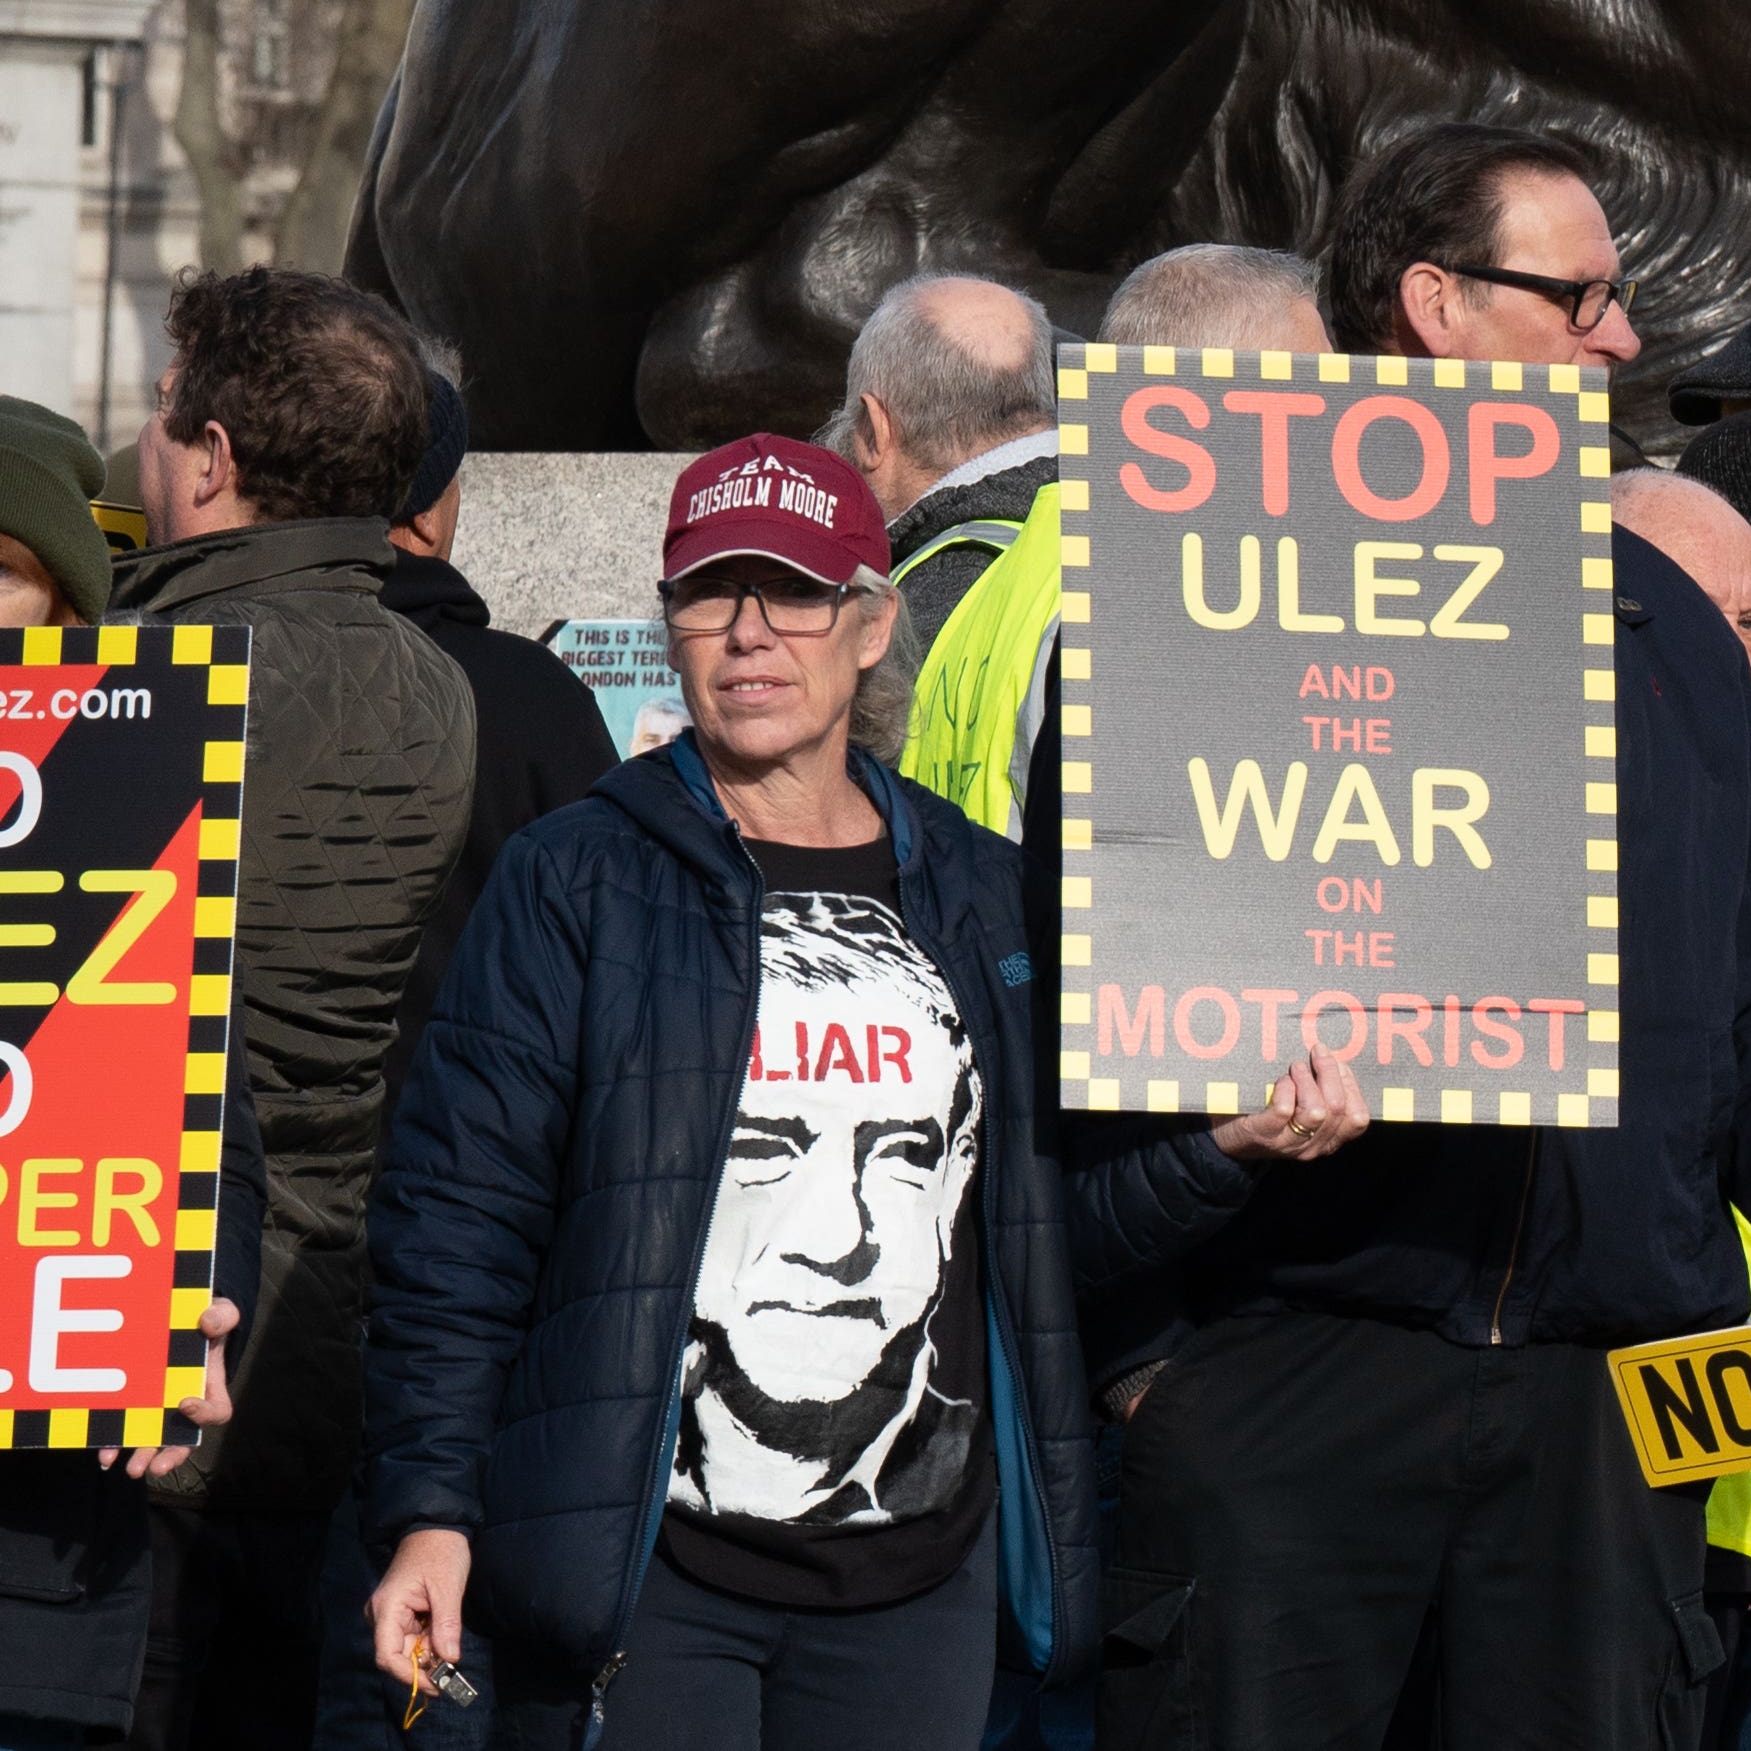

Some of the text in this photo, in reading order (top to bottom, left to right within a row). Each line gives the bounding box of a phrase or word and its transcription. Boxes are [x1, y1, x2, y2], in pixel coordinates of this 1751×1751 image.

[718, 454, 816, 486] TEAM
[1118, 384, 1562, 527] STOP
[686, 475, 839, 530] CHISHOLM MOORE
[1181, 531, 1511, 641] ULEZ
[574, 629, 610, 646] THIS
[615, 629, 630, 646] IS
[561, 650, 626, 667] BIGGEST
[642, 671, 677, 687] HAS
[1298, 663, 1395, 702] AND
[1301, 715, 1393, 755] THE
[1186, 756, 1493, 870] WAR
[1315, 875, 1383, 915] ON
[1303, 929, 1396, 968] THE
[1096, 983, 1586, 1072] MOTORIST
[749, 1020, 913, 1084] LIAR
